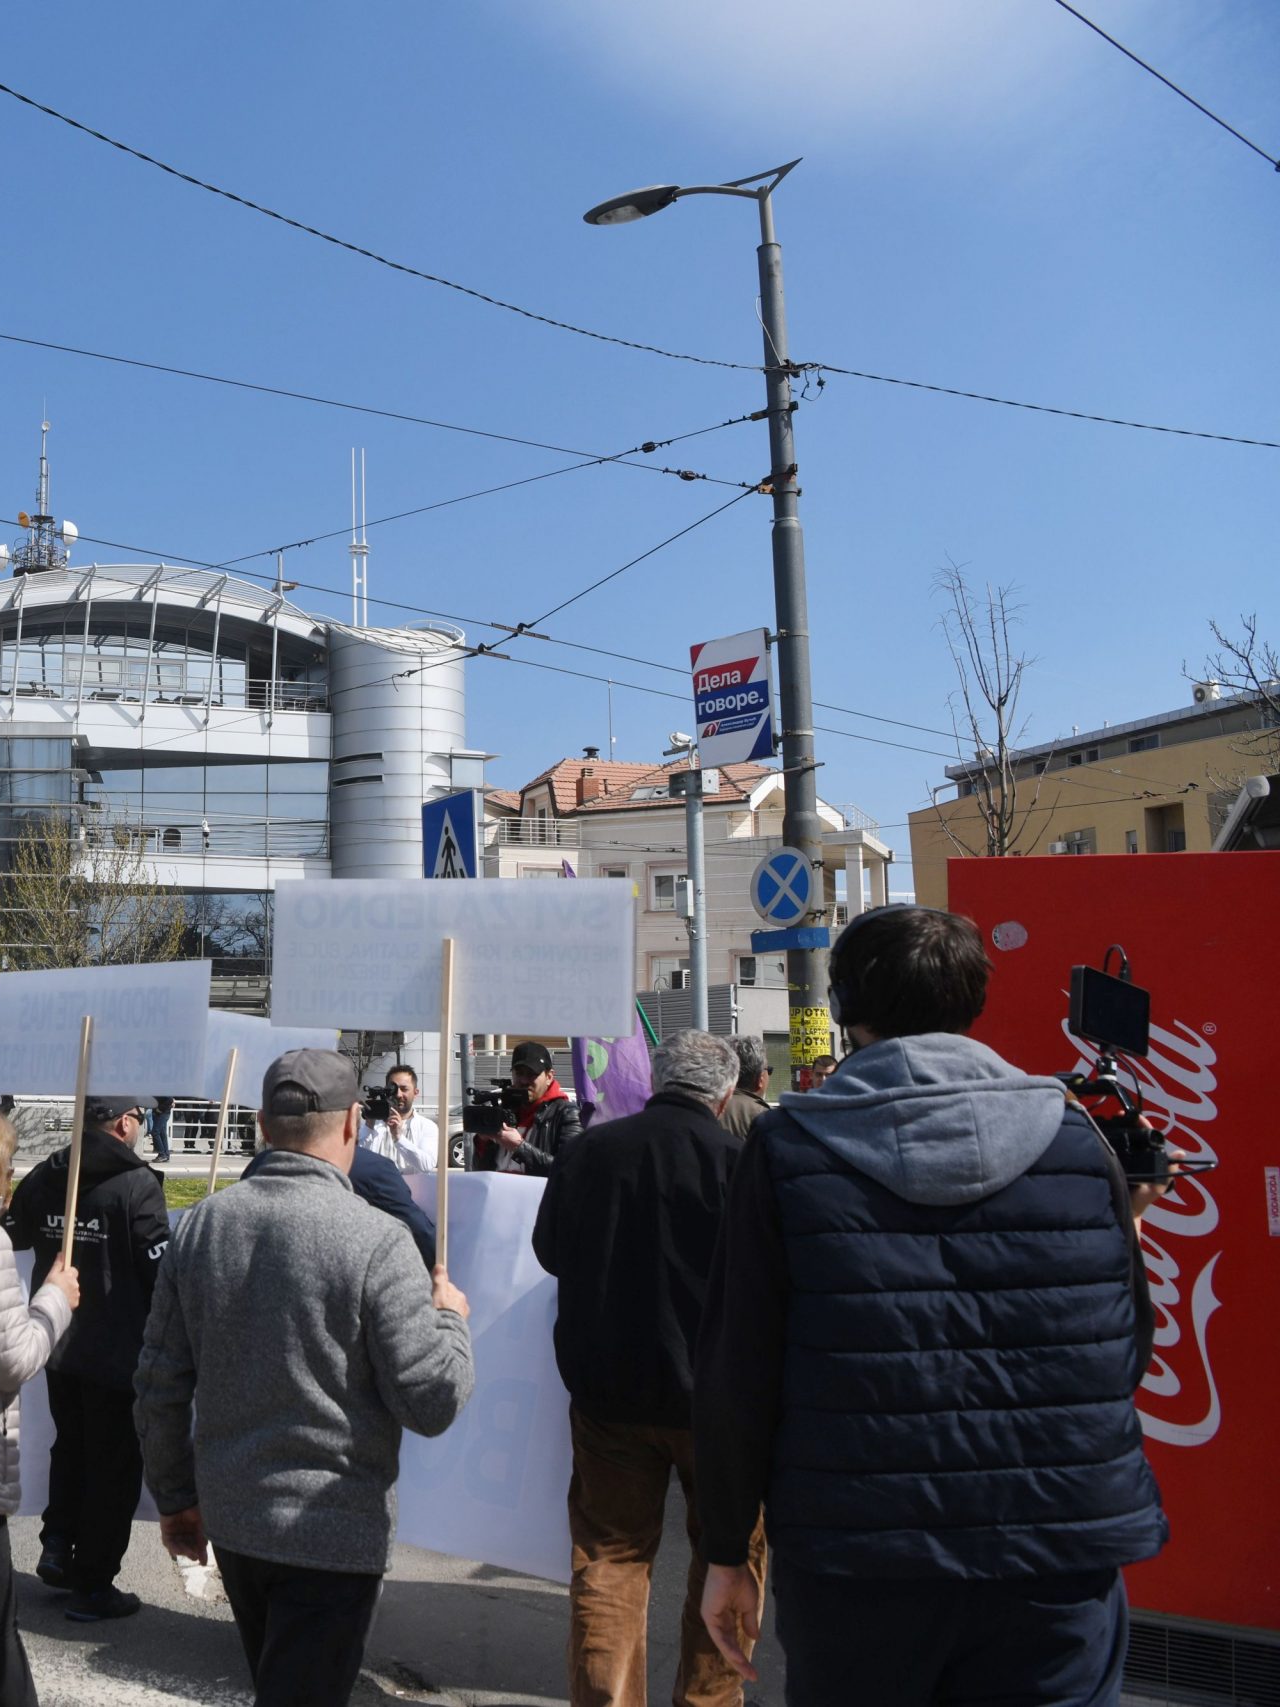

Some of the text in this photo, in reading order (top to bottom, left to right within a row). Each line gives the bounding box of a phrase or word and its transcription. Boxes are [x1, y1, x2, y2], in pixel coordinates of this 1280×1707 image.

[697, 670, 741, 695] Дела
[698, 690, 764, 716] говоре.
[47, 1214, 100, 1231] UT-4
